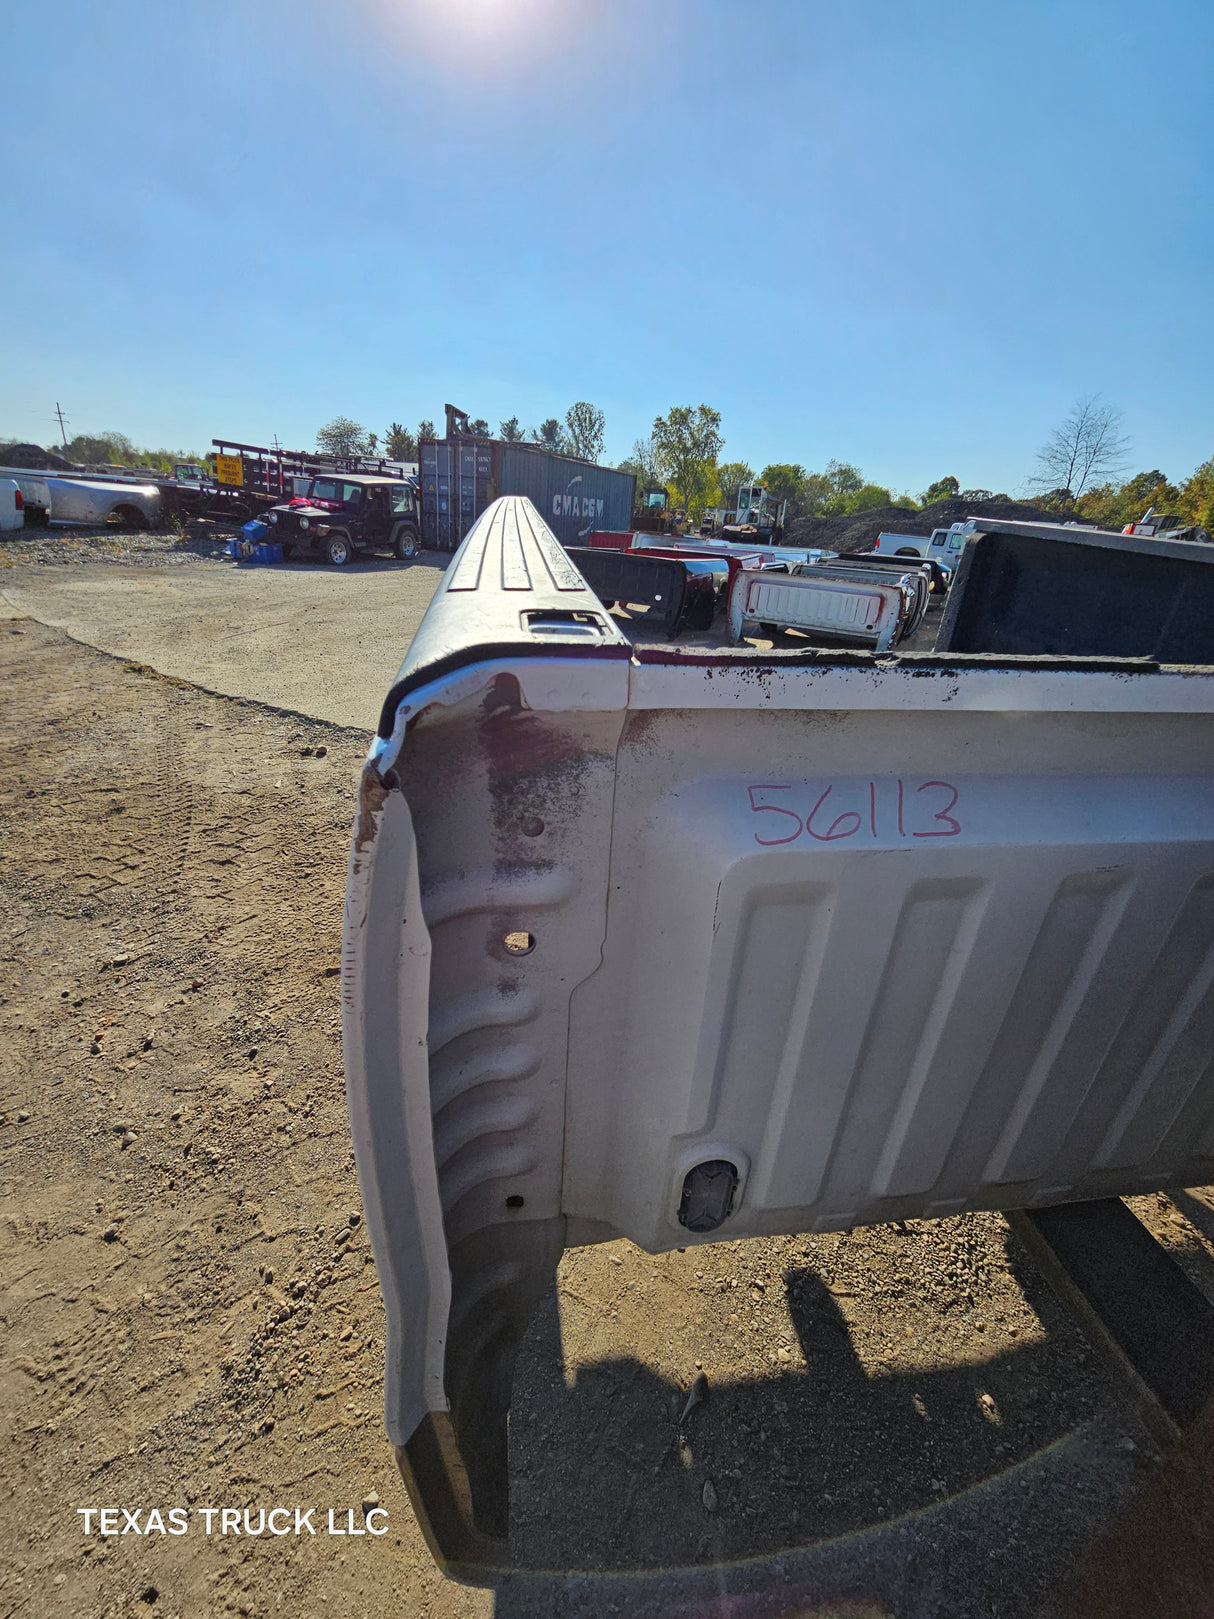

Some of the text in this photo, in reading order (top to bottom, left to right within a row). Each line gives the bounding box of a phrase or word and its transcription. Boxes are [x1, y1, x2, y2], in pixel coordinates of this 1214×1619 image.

[552, 494, 604, 518] CMA CGM
[748, 779, 961, 846] 56113
